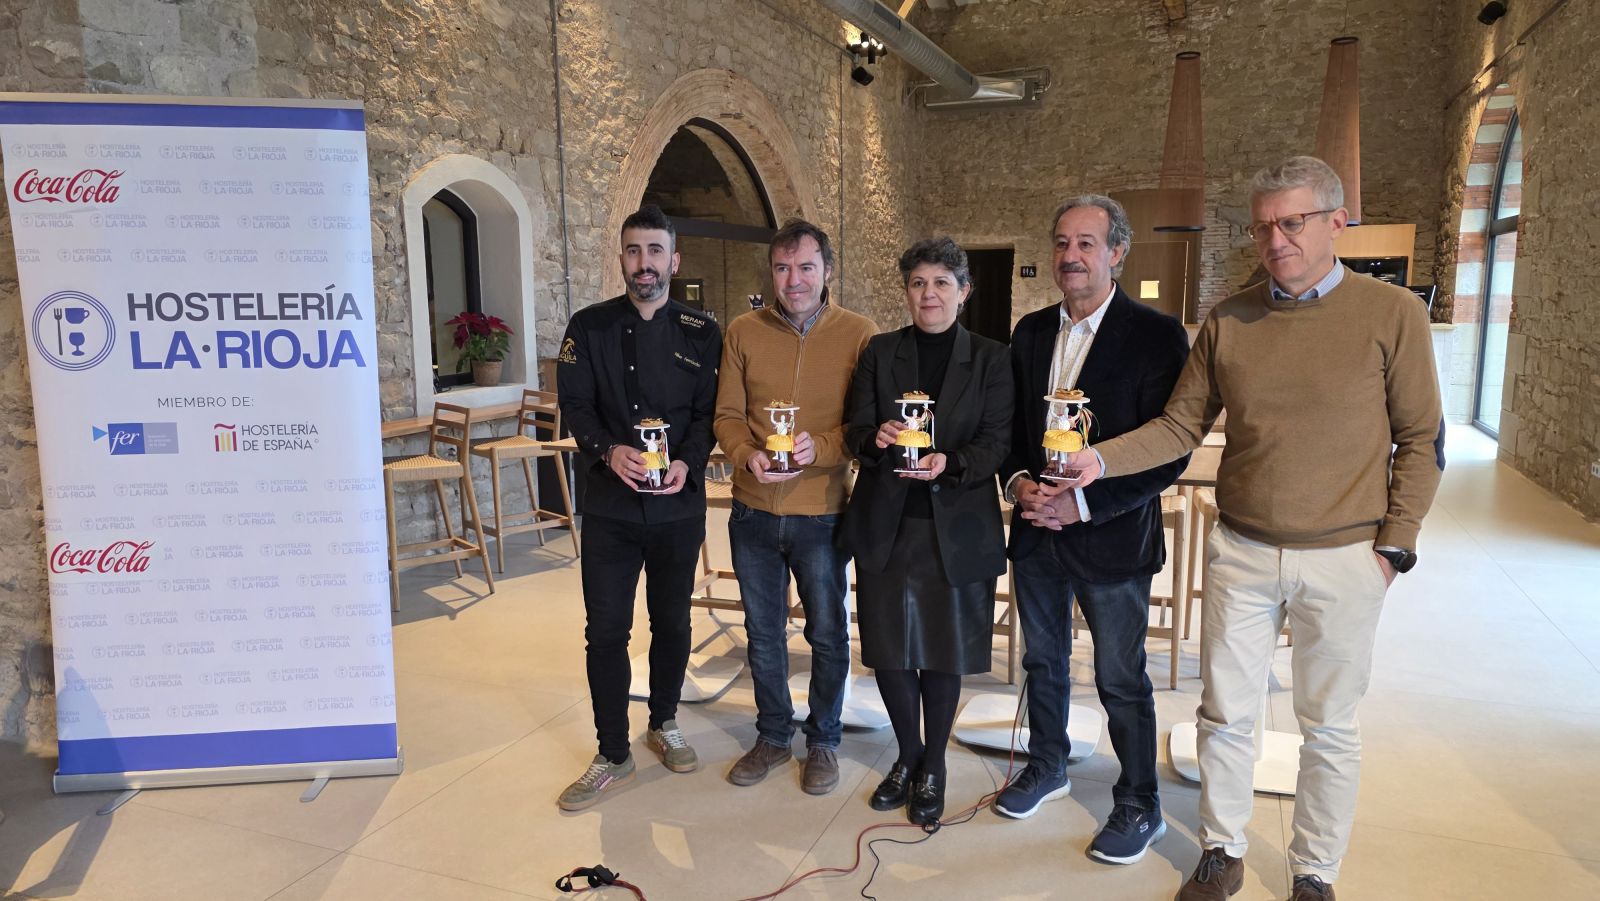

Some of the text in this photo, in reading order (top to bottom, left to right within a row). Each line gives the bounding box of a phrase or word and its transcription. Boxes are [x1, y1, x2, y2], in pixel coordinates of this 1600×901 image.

[14, 168, 127, 203] Coca-Cola
[127, 283, 362, 321] HOSTELERÍA
[157, 396, 255, 408] MIEMBRO DE:
[242, 421, 318, 436] HOSTELERÍA
[110, 430, 140, 455] fer
[243, 440, 261, 451] DE
[50, 540, 156, 574] Coca-Cola
